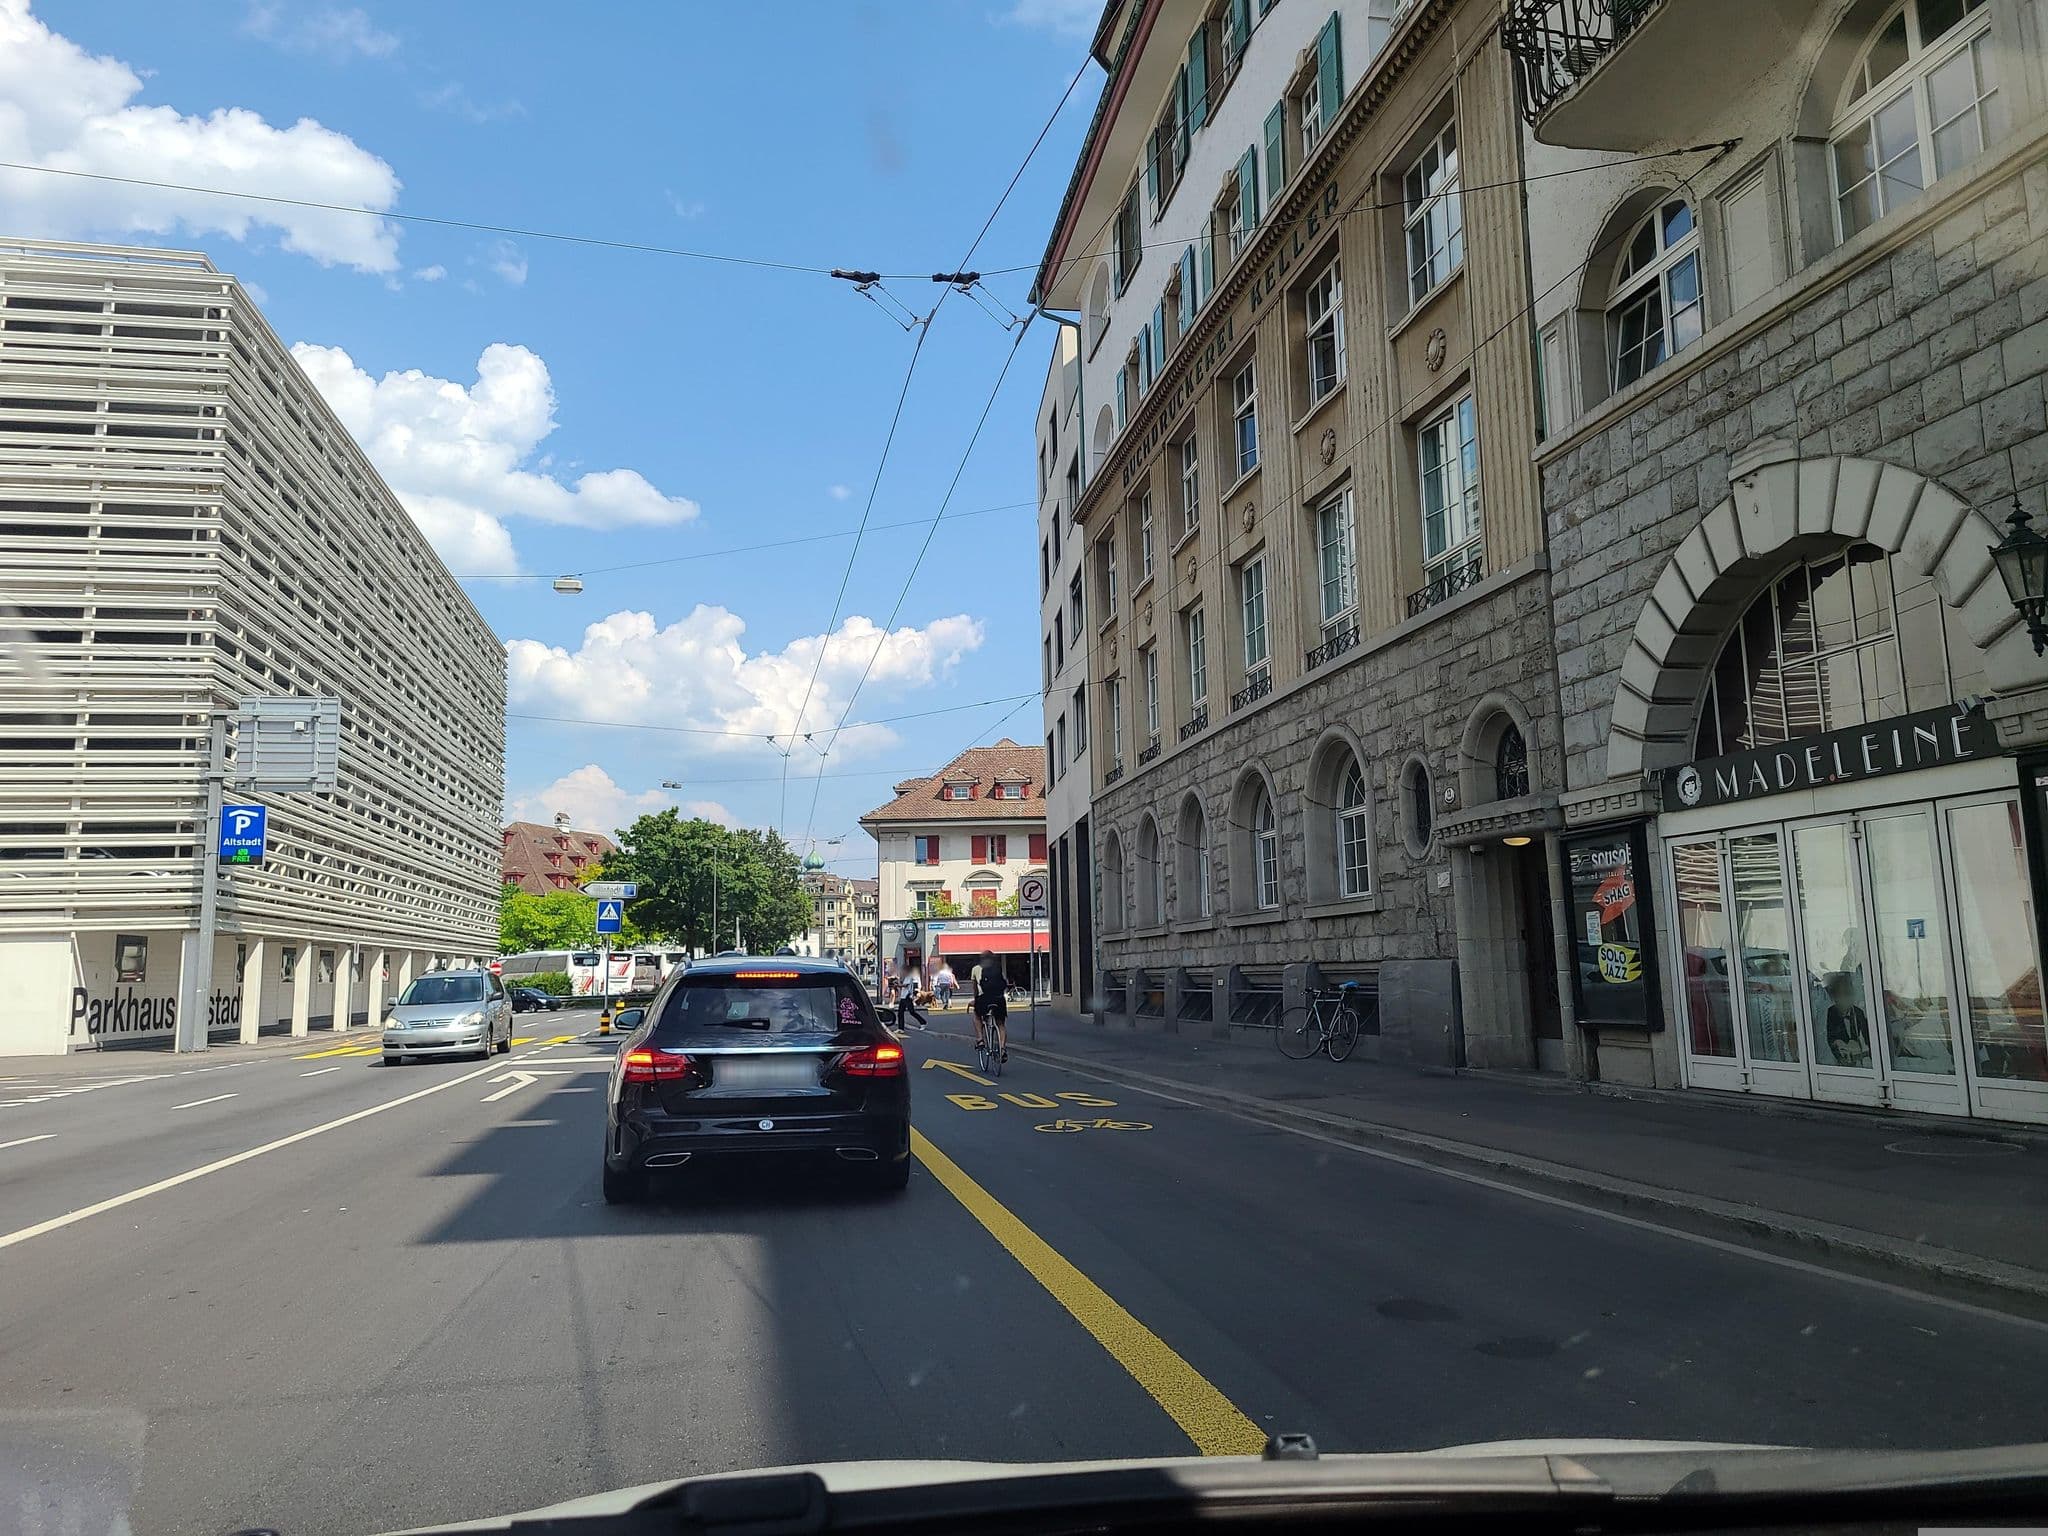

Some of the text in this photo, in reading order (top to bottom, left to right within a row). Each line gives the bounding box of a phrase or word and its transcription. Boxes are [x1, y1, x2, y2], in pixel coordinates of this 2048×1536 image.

[1122, 181, 1339, 488] BUCHDRUCKEREI KELLER
[1714, 714, 1974, 799] MADELEINE
[235, 815, 251, 835] P
[223, 837, 261, 846] Altstadt
[231, 855, 251, 863] FREI
[1604, 883, 1631, 906] SHAG
[1600, 947, 1627, 964] SOLO
[1604, 965, 1628, 981] JAZZ
[69, 986, 176, 1036] Parkhaus
[943, 1091, 1119, 1111] BUS
